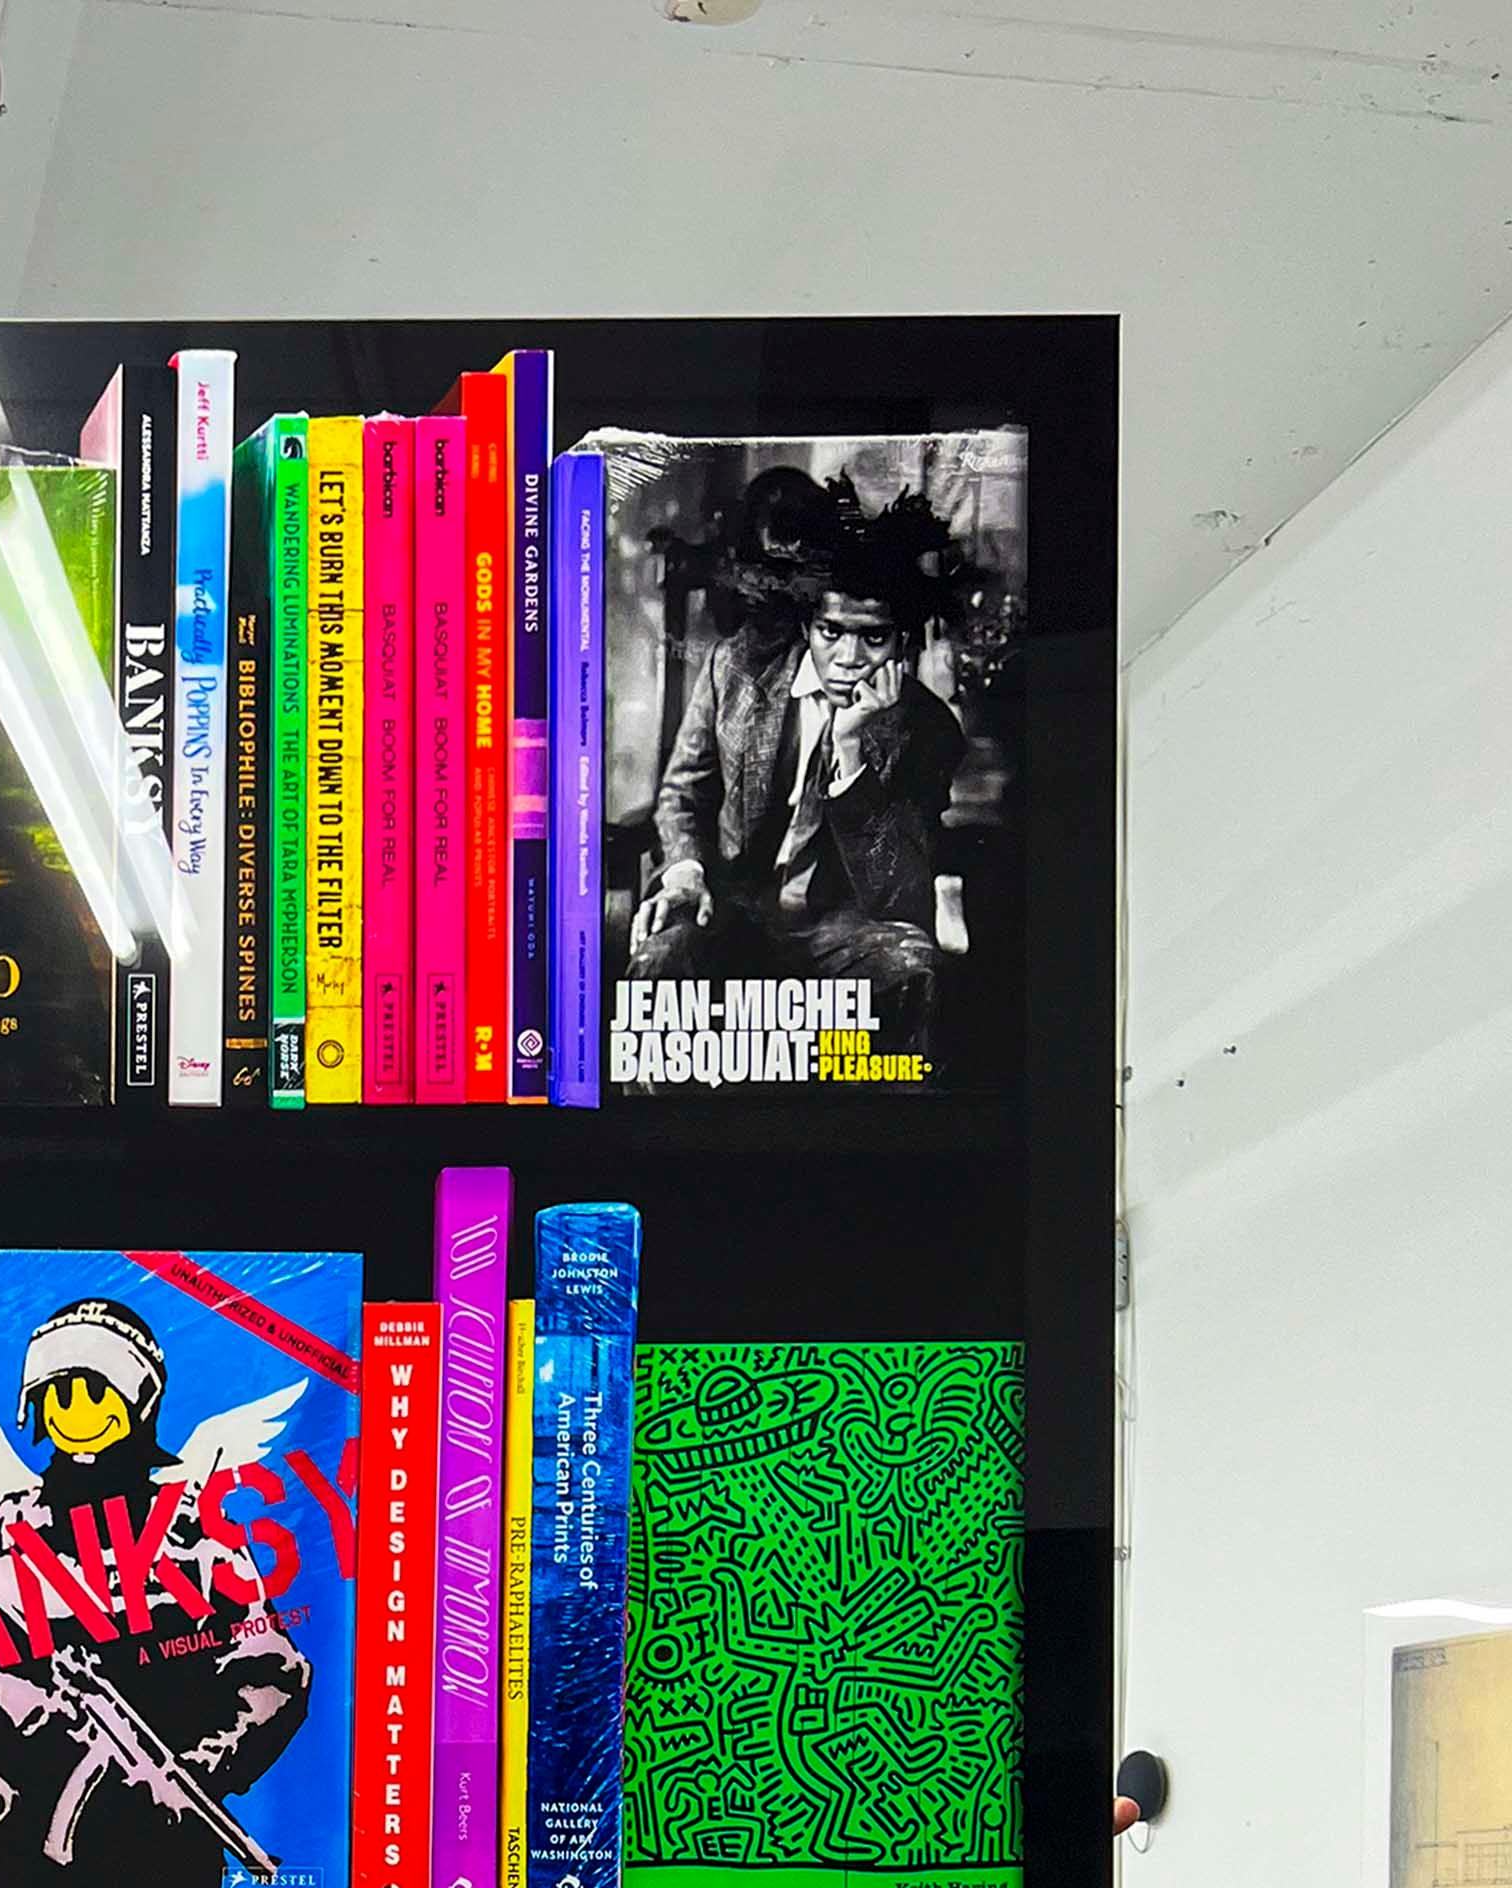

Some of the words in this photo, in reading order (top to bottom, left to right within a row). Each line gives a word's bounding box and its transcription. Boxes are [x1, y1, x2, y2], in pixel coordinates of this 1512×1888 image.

[319, 471, 345, 523] LET'S
[525, 474, 538, 538] DIVINE
[319, 529, 344, 584] BURN
[476, 552, 493, 613] GODS
[319, 590, 344, 635] THIS
[525, 546, 538, 633] GARDENS
[382, 604, 396, 700] BASQUIAT
[476, 618, 492, 643] IN
[319, 642, 344, 732] MOMENT
[476, 648, 492, 678] MY
[237, 659, 256, 817] BIBLIOPHILE:
[476, 685, 493, 748] HOME
[318, 739, 343, 795] DOWN
[382, 719, 396, 784] BOOM
[318, 802, 343, 832] TO
[382, 791, 396, 828] FOR
[237, 825, 256, 927] DIVERSE
[318, 834, 343, 870] THE
[382, 833, 396, 886] REAL
[318, 877, 342, 948] FILTER
[237, 934, 256, 1021] SPINES
[610, 979, 880, 1031] JEAN-MICHEL
[135, 1002, 147, 1074] PRESTEL
[819, 1030, 870, 1055] KING
[374, 1336, 430, 1347] MILLMAN
[380, 1322, 424, 1333] DEBBIE
[557, 1393, 576, 1495] American
[584, 1392, 602, 1456] Three
[554, 1502, 575, 1563] Prints
[580, 1462, 601, 1564] Centuries
[579, 1567, 599, 1590] of
[138, 1643, 151, 1664] A
[159, 1629, 223, 1659] VISUAL
[230, 1606, 313, 1643] PROTEST
[541, 1803, 603, 1813] NATIONAL
[545, 1819, 598, 1829] GALLERY
[531, 1850, 613, 1860] WASHINGTON
[550, 1834, 565, 1844] OF
